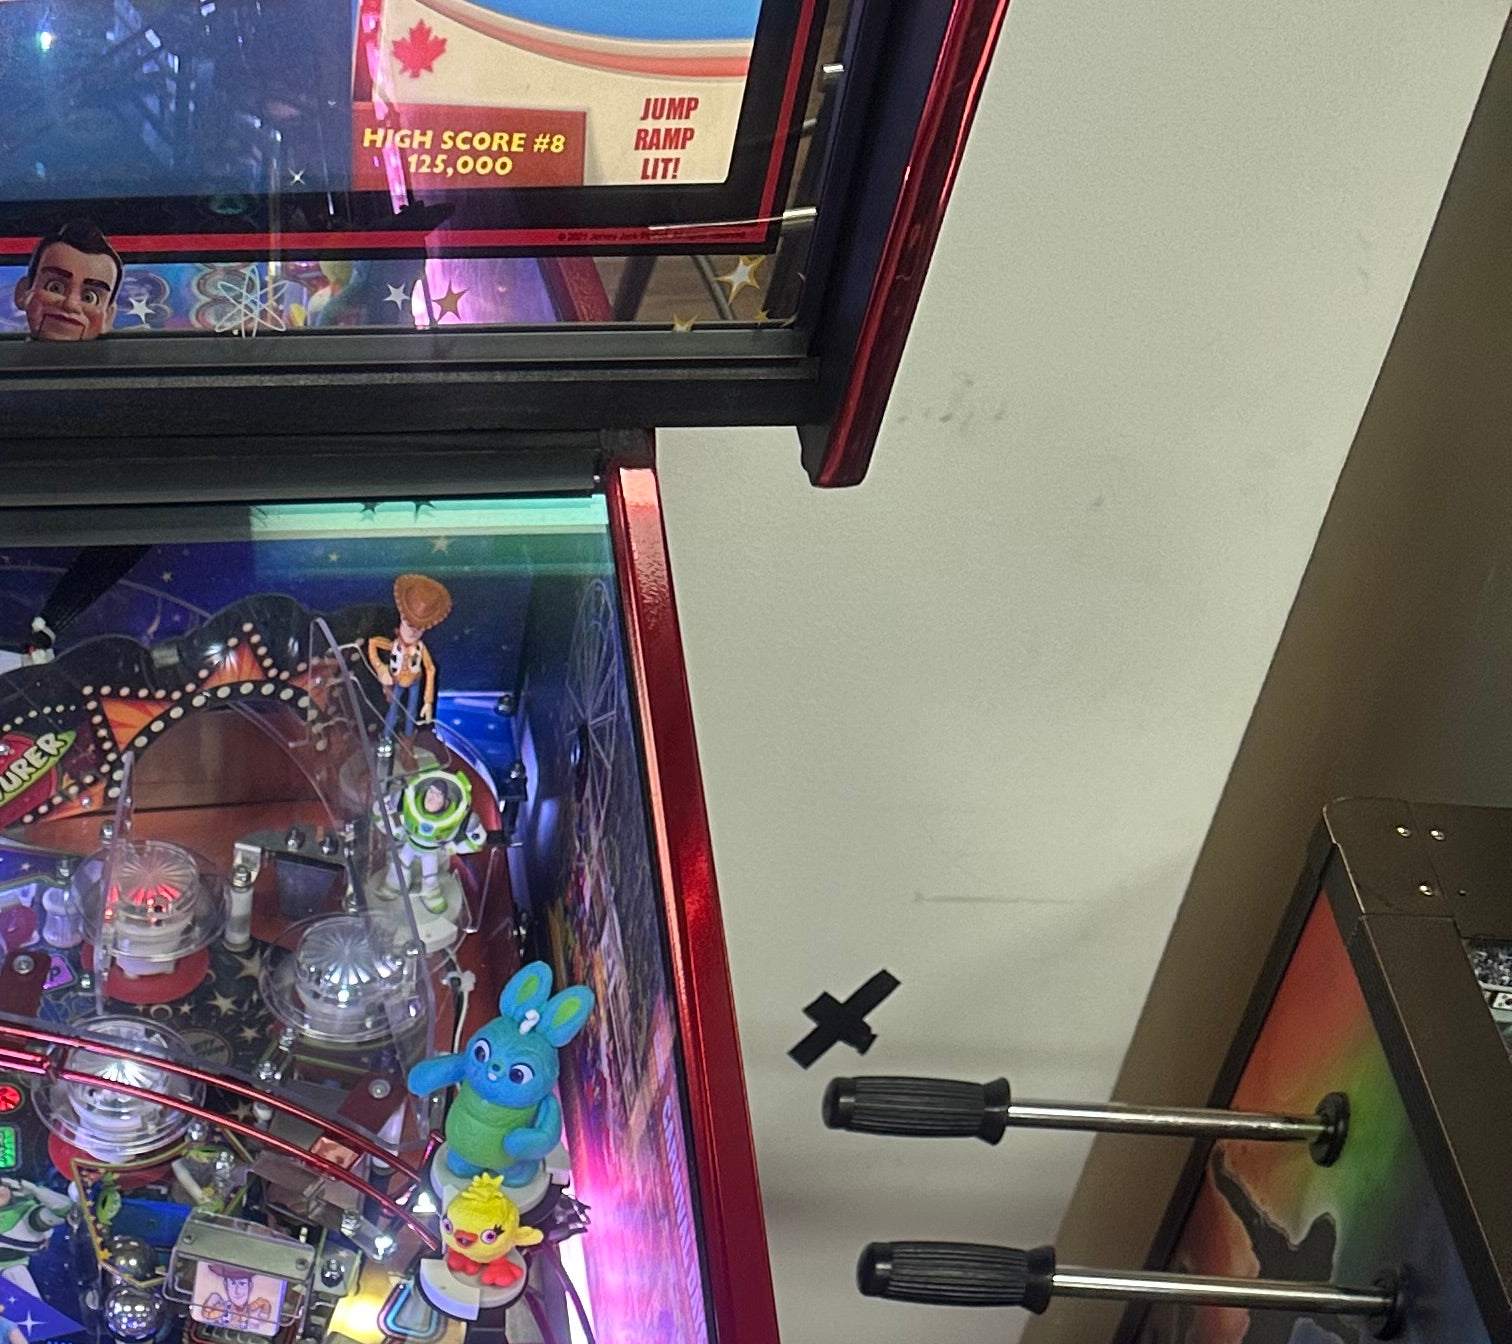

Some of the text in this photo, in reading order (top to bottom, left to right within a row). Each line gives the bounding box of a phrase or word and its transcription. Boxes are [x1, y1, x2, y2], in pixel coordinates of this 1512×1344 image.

[640, 97, 700, 121] JUMP
[363, 128, 566, 154] HIGH SCORE #8
[634, 128, 695, 151] RAMP
[407, 155, 513, 178] 125,000
[640, 157, 679, 180] LIT!
